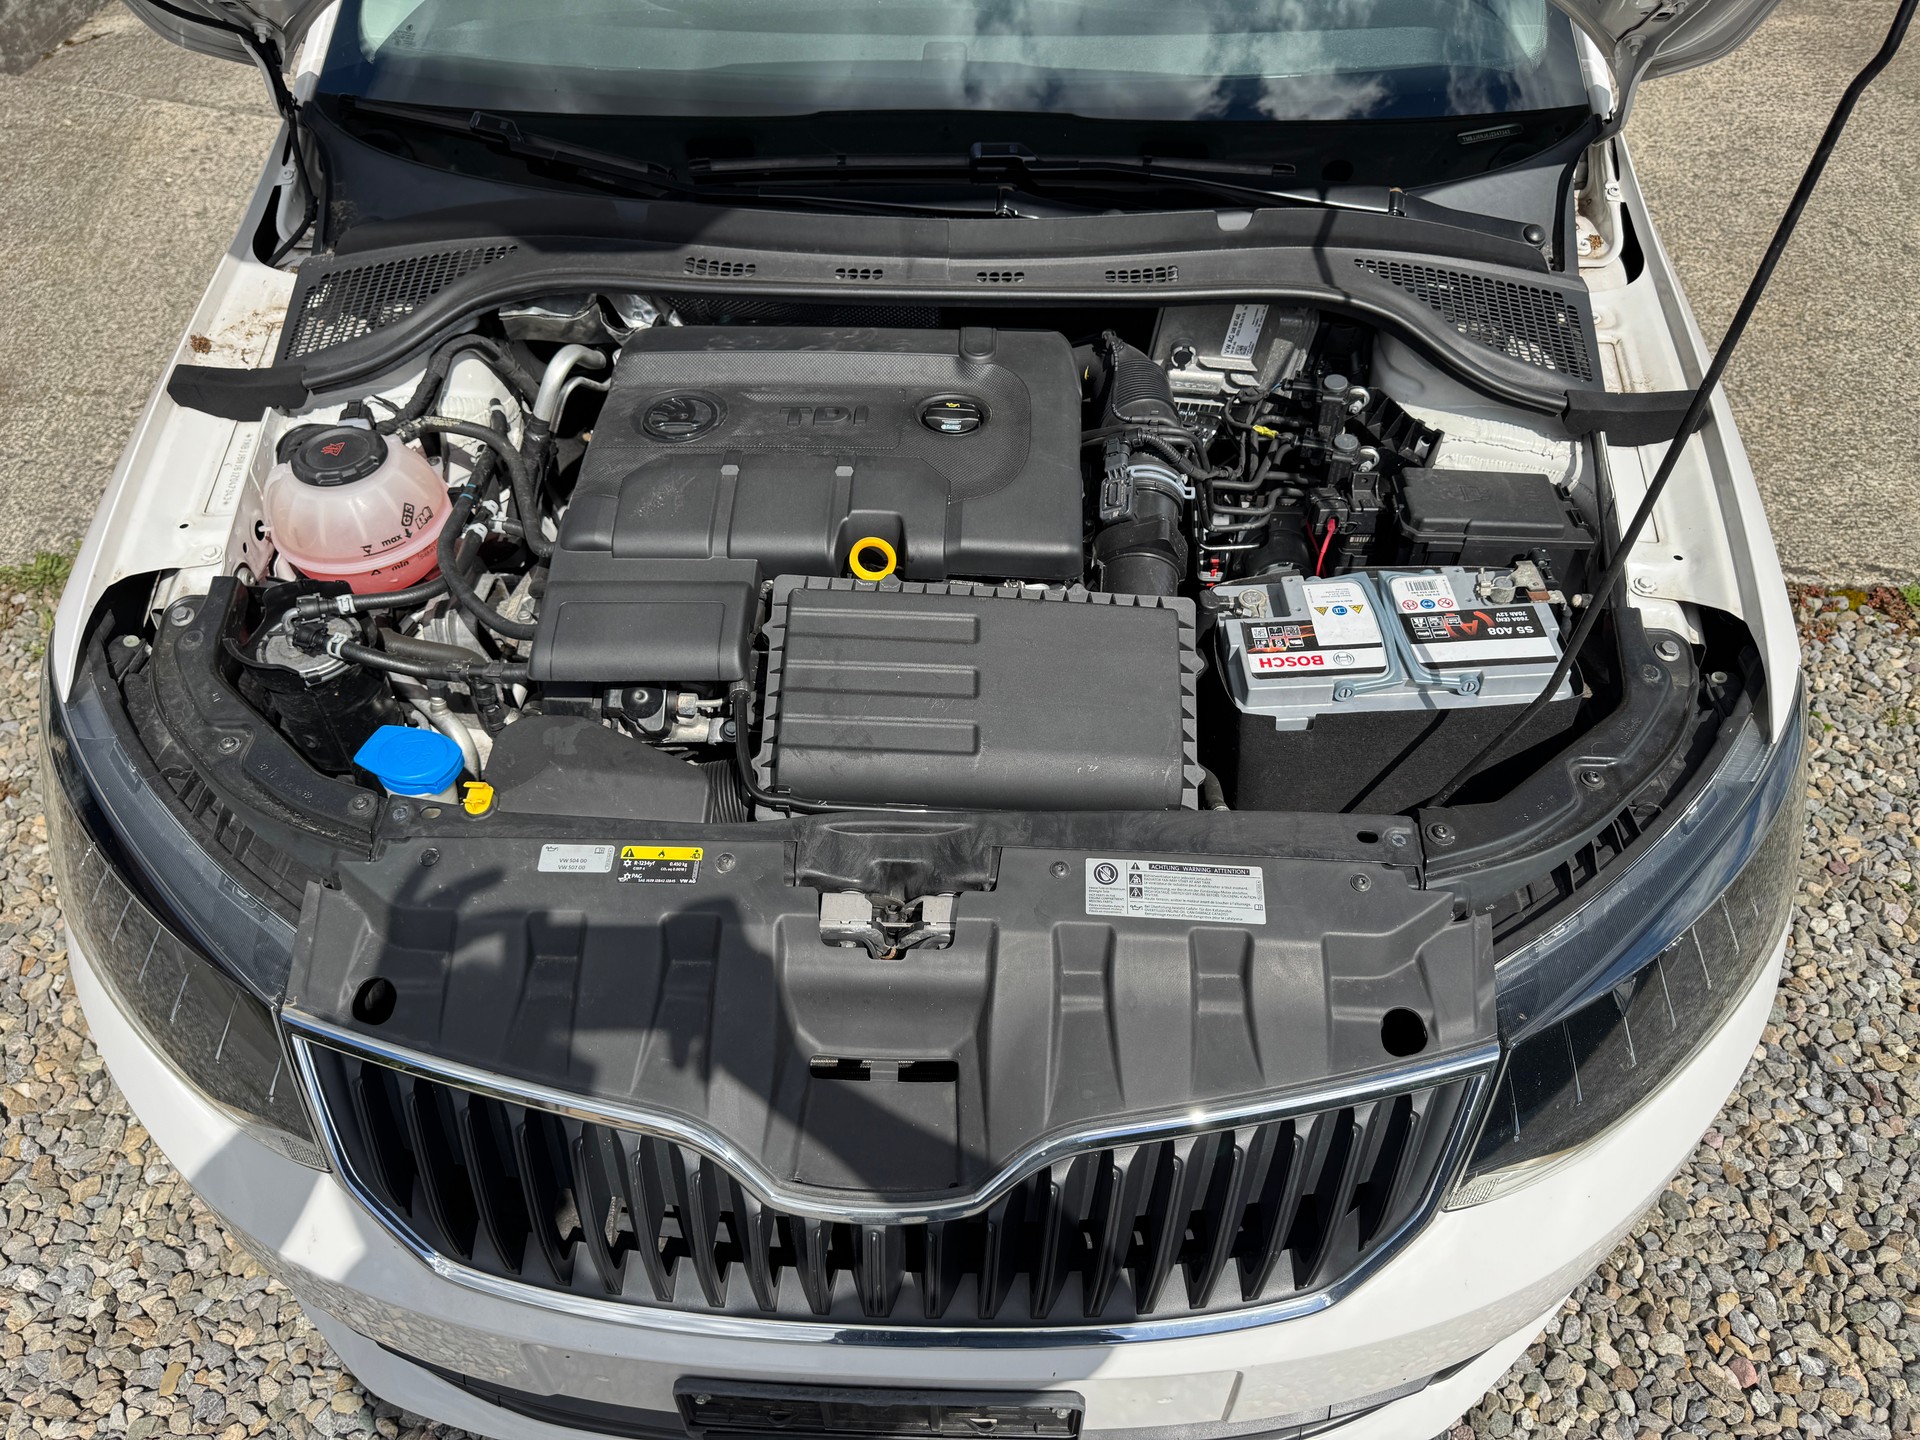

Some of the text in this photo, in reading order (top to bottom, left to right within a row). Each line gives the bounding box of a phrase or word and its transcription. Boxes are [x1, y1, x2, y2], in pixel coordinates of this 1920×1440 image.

[780, 404, 870, 427] TDI
[402, 505, 413, 525] G13
[382, 534, 403, 547] max
[391, 561, 410, 571] min
[1487, 627, 1512, 635] A08
[1259, 655, 1324, 668] BOSCH
